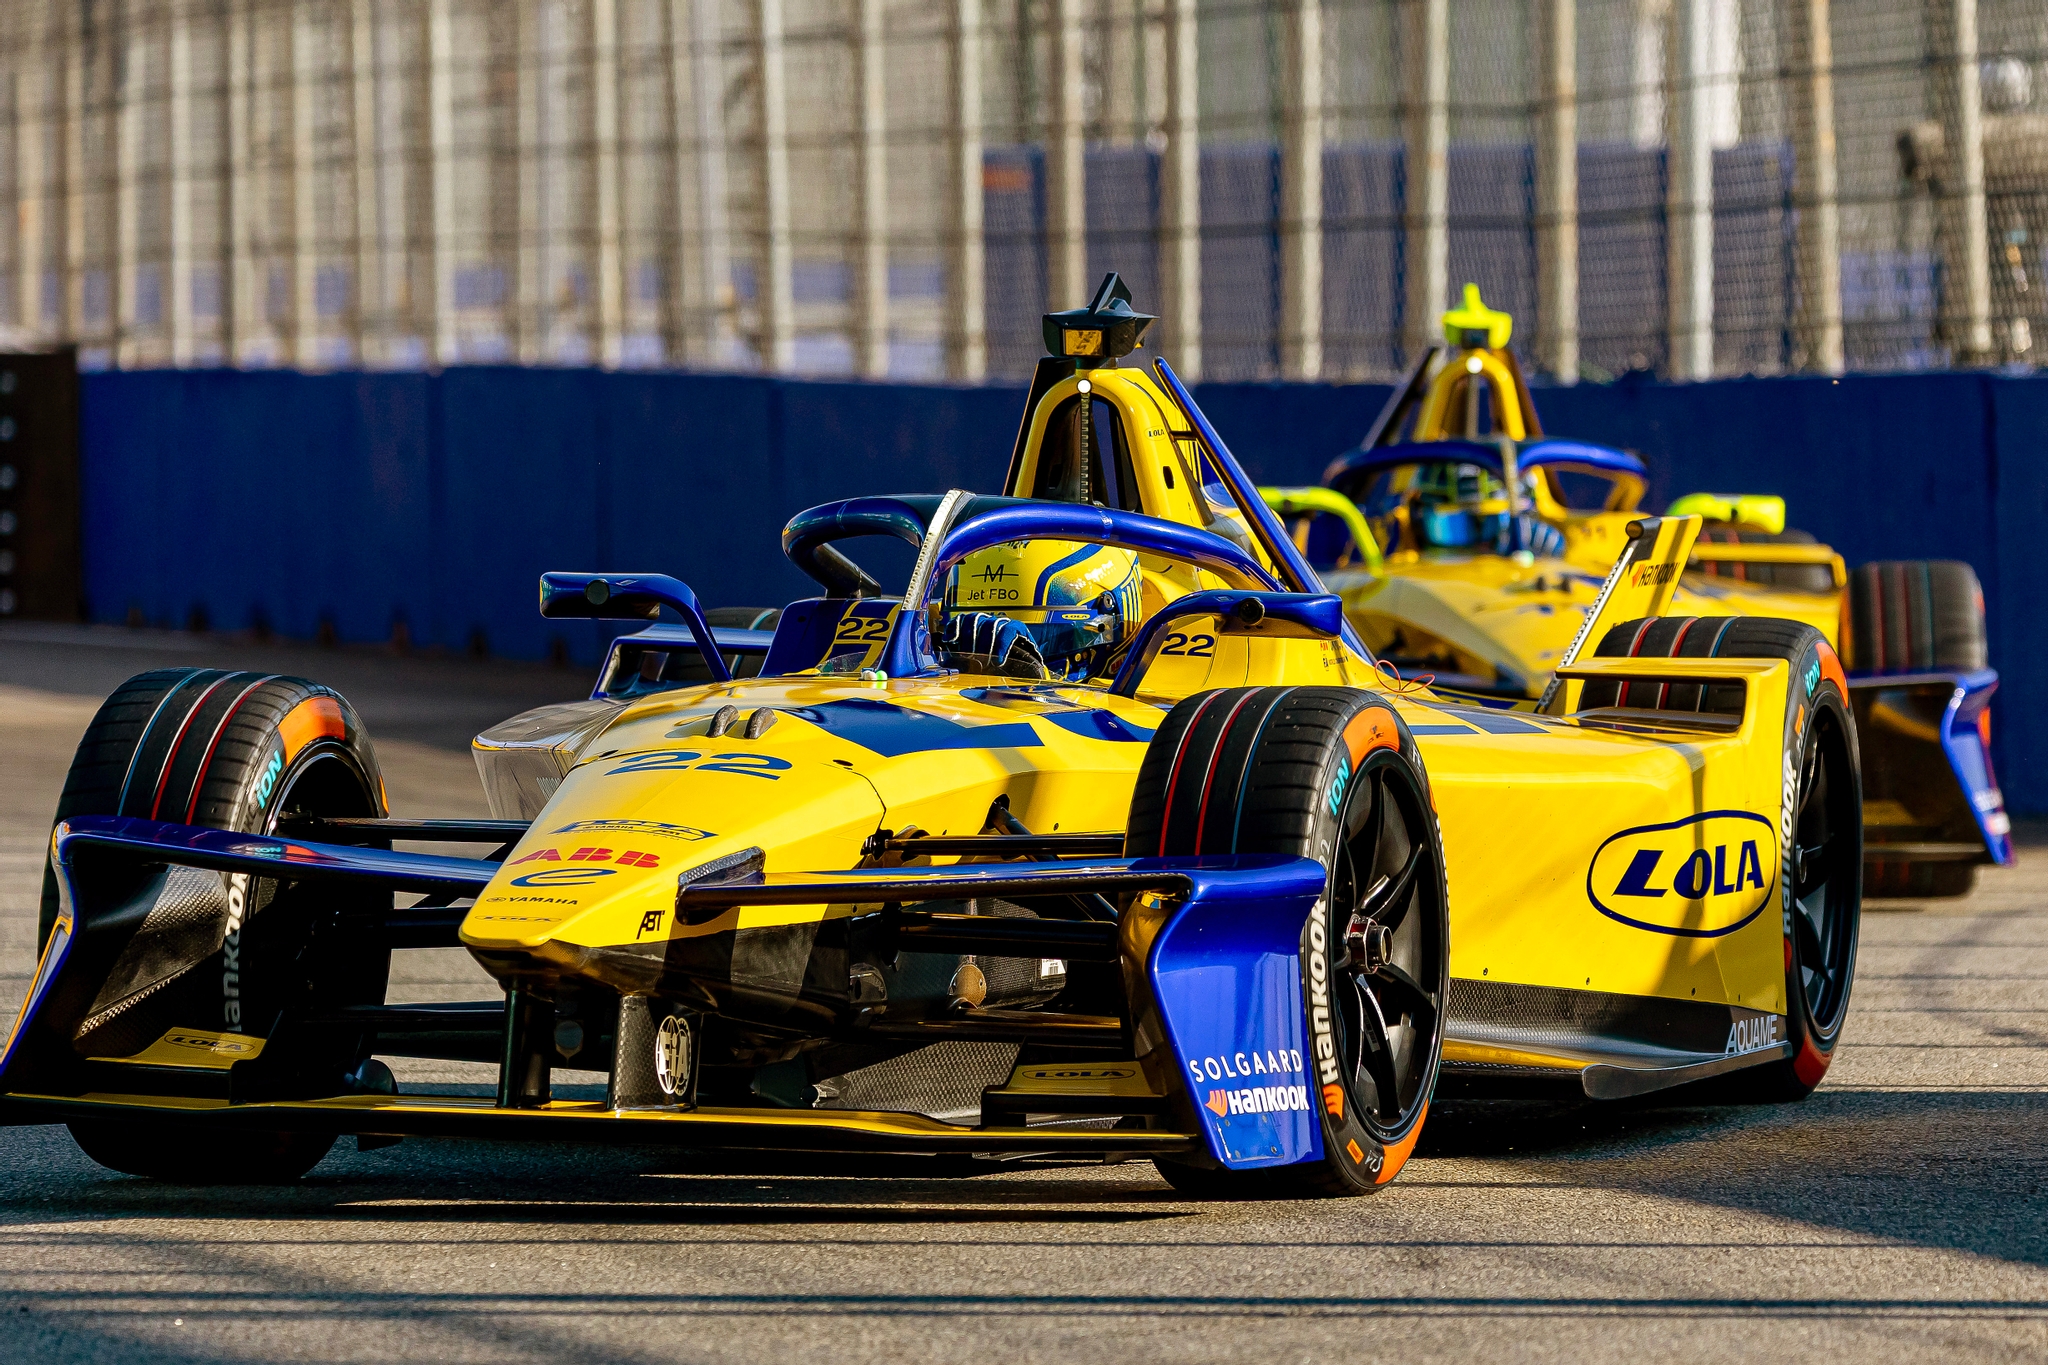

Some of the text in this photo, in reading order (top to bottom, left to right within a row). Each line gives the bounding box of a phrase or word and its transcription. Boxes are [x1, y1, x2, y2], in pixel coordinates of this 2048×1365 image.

[967, 588, 1019, 600] Jet FBO
[836, 618, 890, 641] 22
[1161, 633, 1215, 657] 22
[604, 752, 792, 780] 22
[507, 848, 660, 868] ABB
[1611, 840, 1765, 899] LOLA
[510, 897, 578, 905] YAMAHA
[636, 910, 666, 939] ABT
[172, 1037, 241, 1050] LOLA
[1190, 1050, 1302, 1082] SOLGAARD
